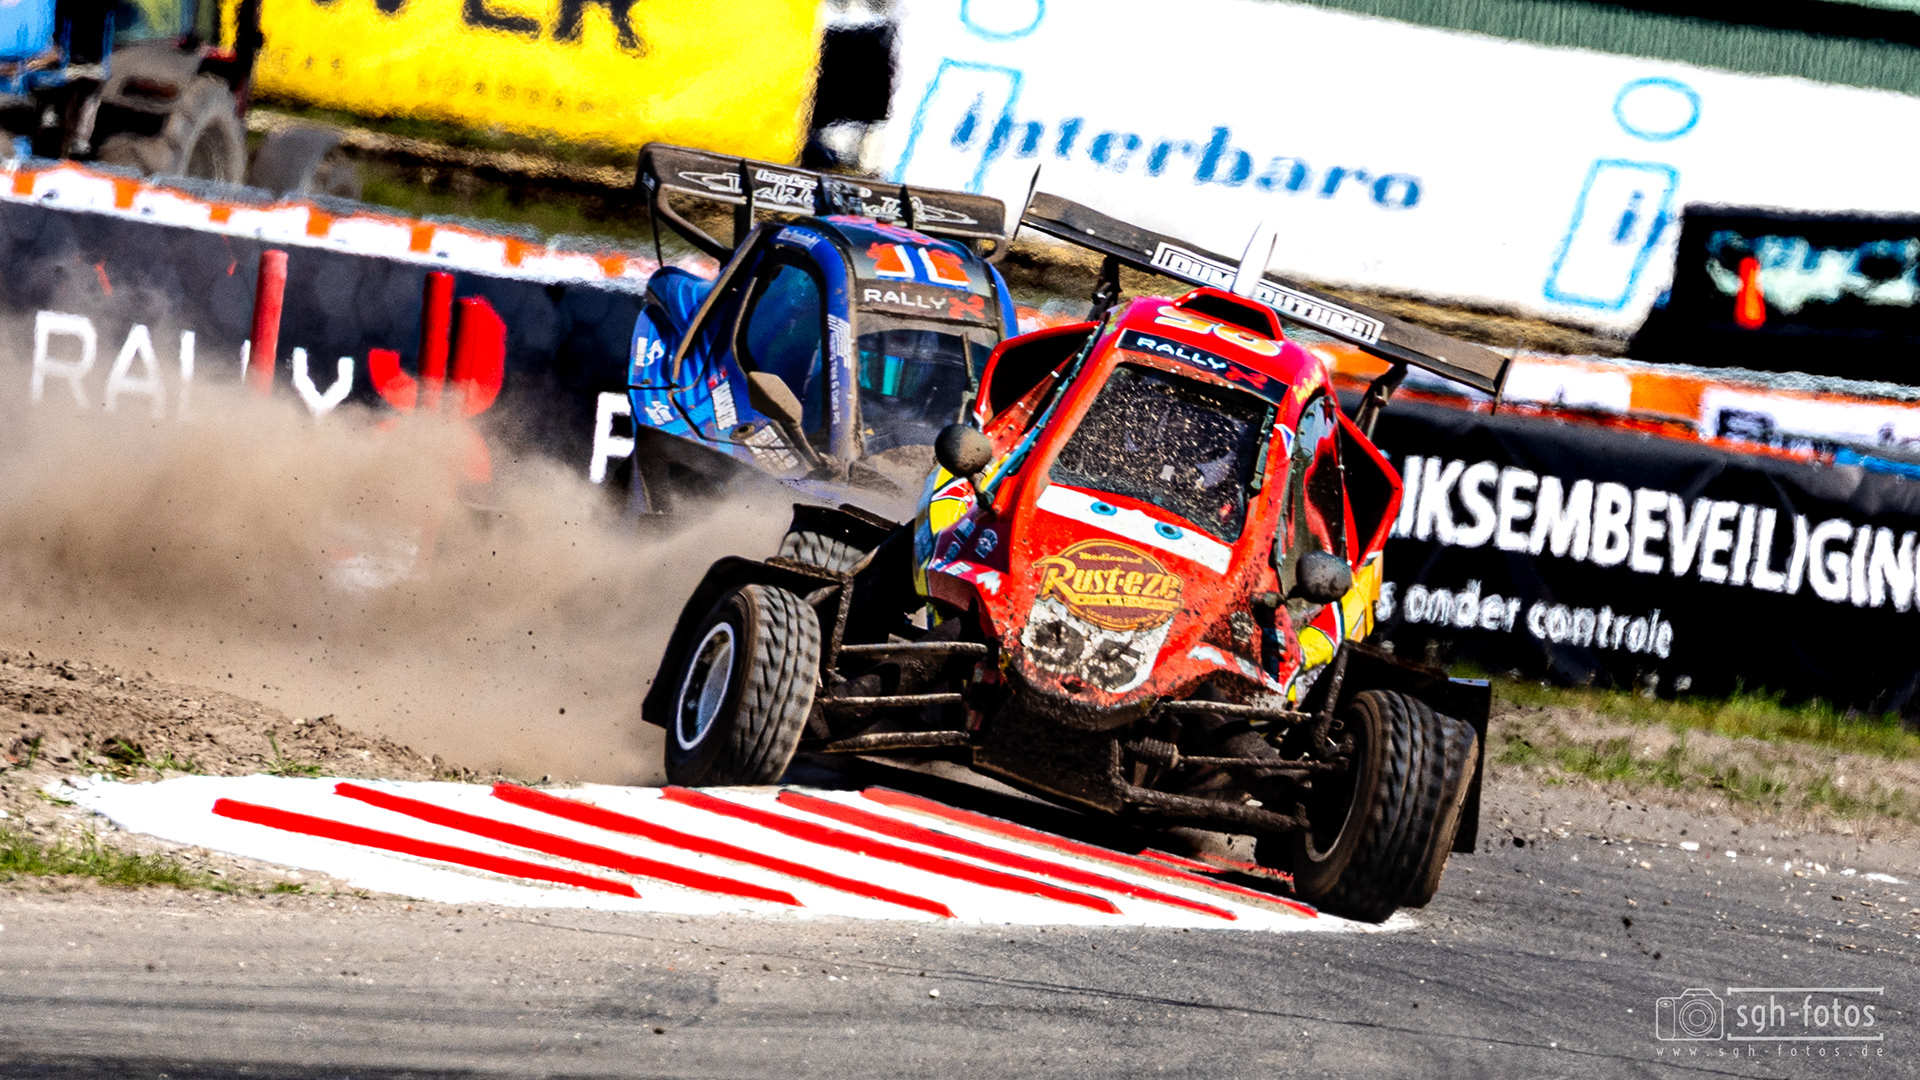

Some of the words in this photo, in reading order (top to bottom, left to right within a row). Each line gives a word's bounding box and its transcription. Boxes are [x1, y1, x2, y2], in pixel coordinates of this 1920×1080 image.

[1389, 453, 1920, 612] IKSEMBEVEILIGIN
[1403, 578, 1519, 633] onder
[1527, 599, 1674, 659] controle
